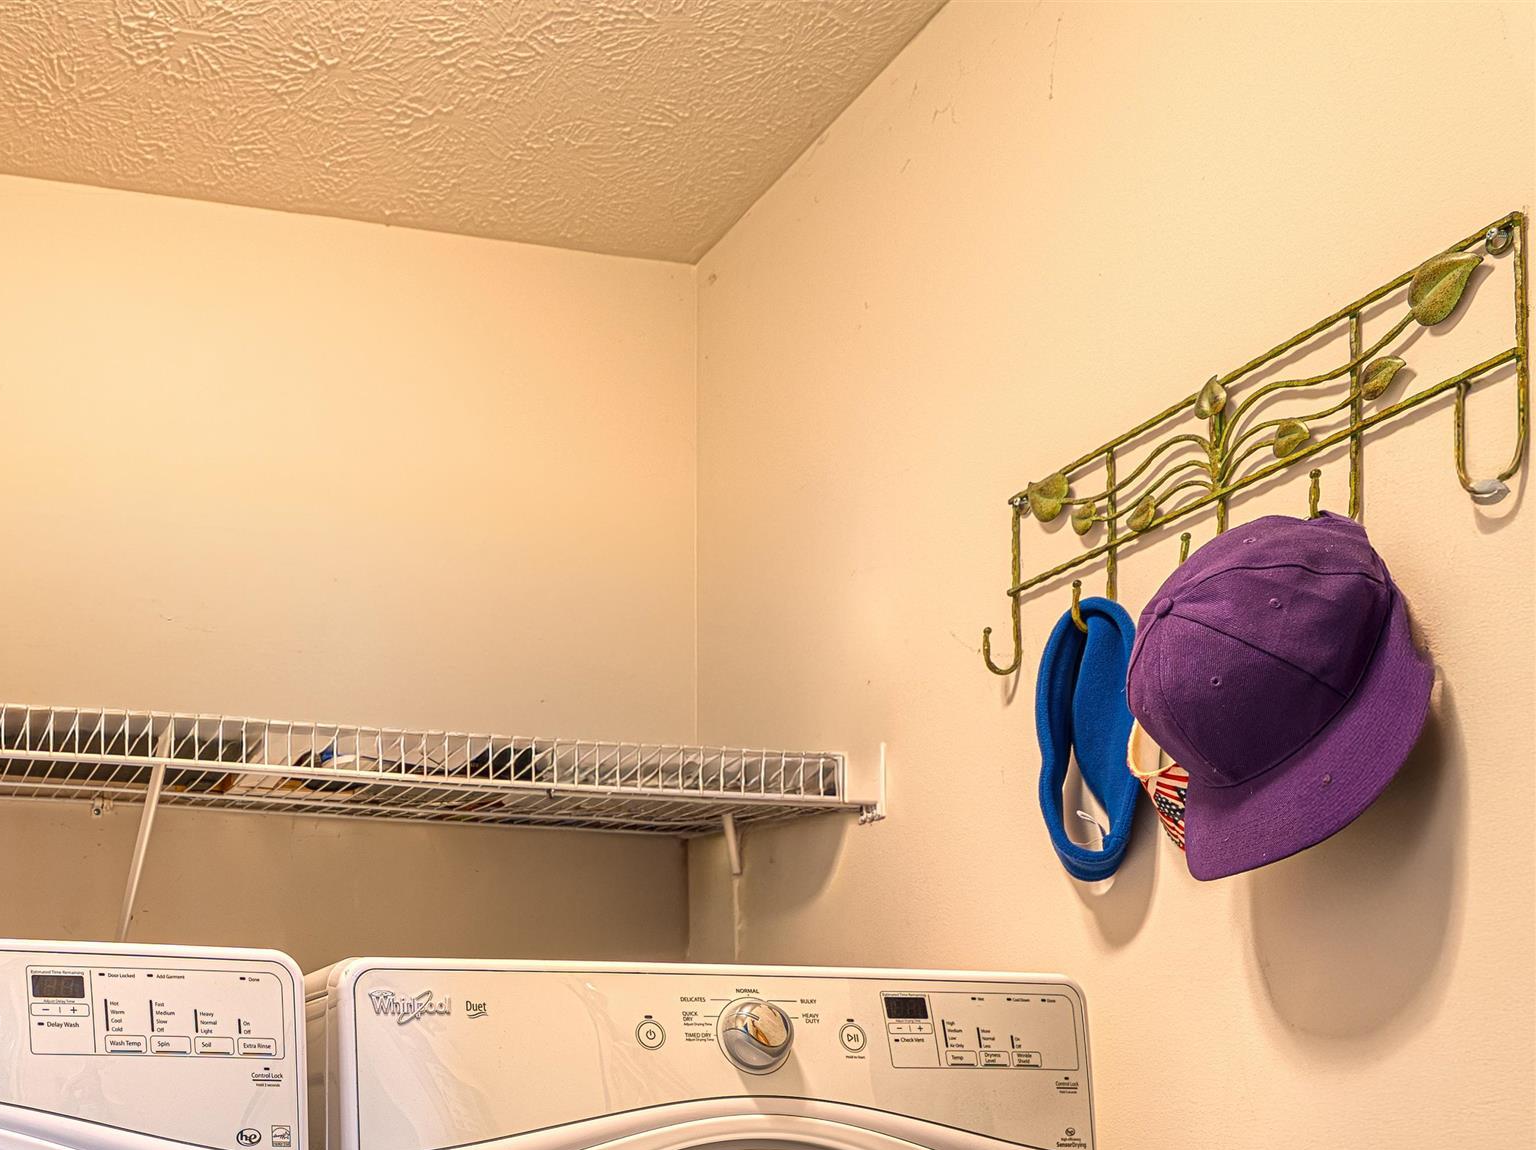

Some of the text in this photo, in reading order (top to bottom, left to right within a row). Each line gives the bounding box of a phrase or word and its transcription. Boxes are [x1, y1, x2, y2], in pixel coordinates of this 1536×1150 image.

[369, 993, 452, 1023] Whirlpool
[465, 1000, 487, 1012] Duet
[46, 1021, 63, 1029] Delay
